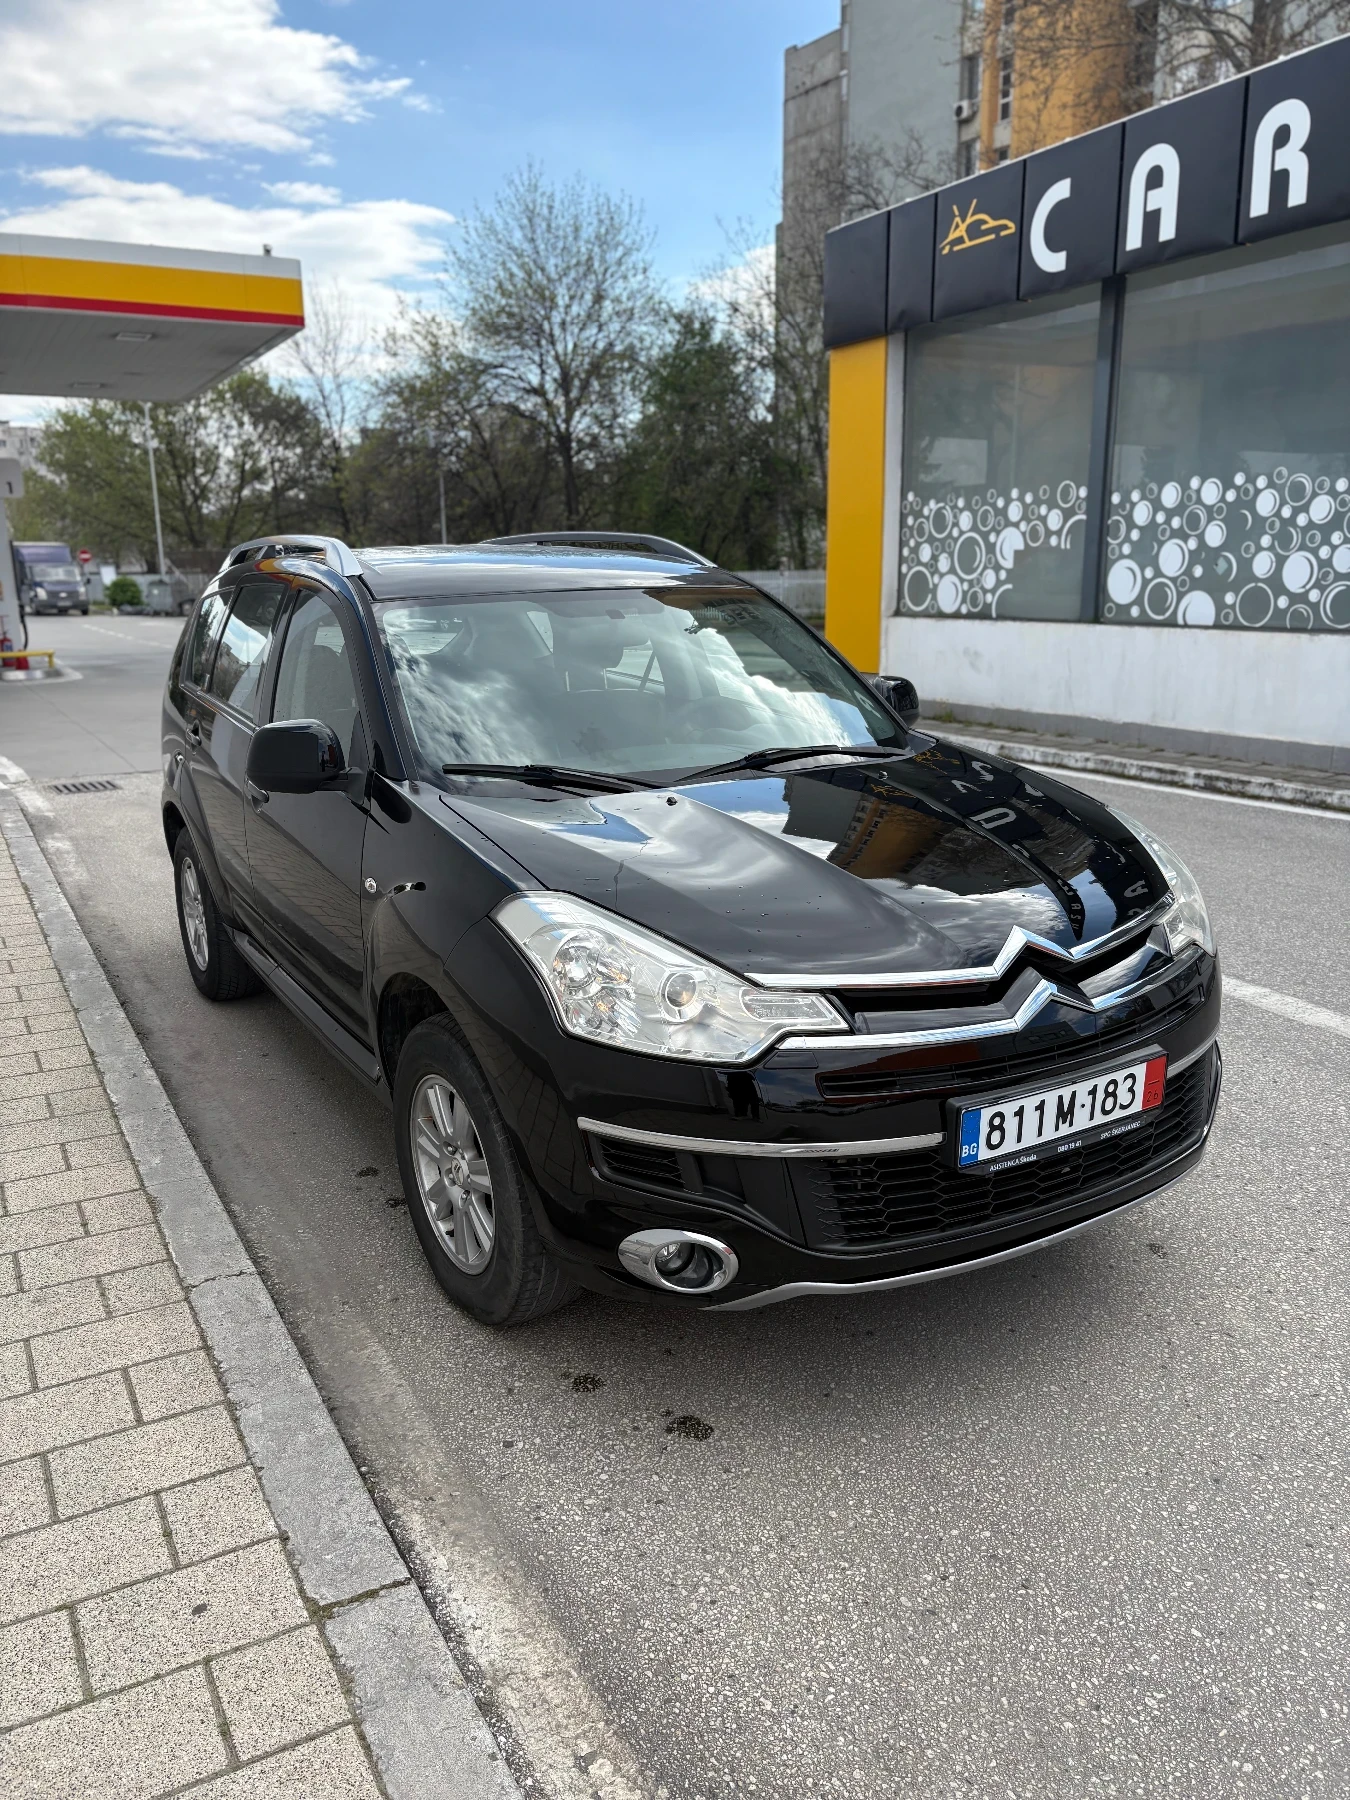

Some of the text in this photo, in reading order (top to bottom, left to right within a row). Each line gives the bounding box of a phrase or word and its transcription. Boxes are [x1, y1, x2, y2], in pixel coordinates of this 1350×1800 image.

[1030, 98, 1311, 273] CAR
[1146, 1088, 1159, 1103] 26
[962, 1143, 978, 1157] BG
